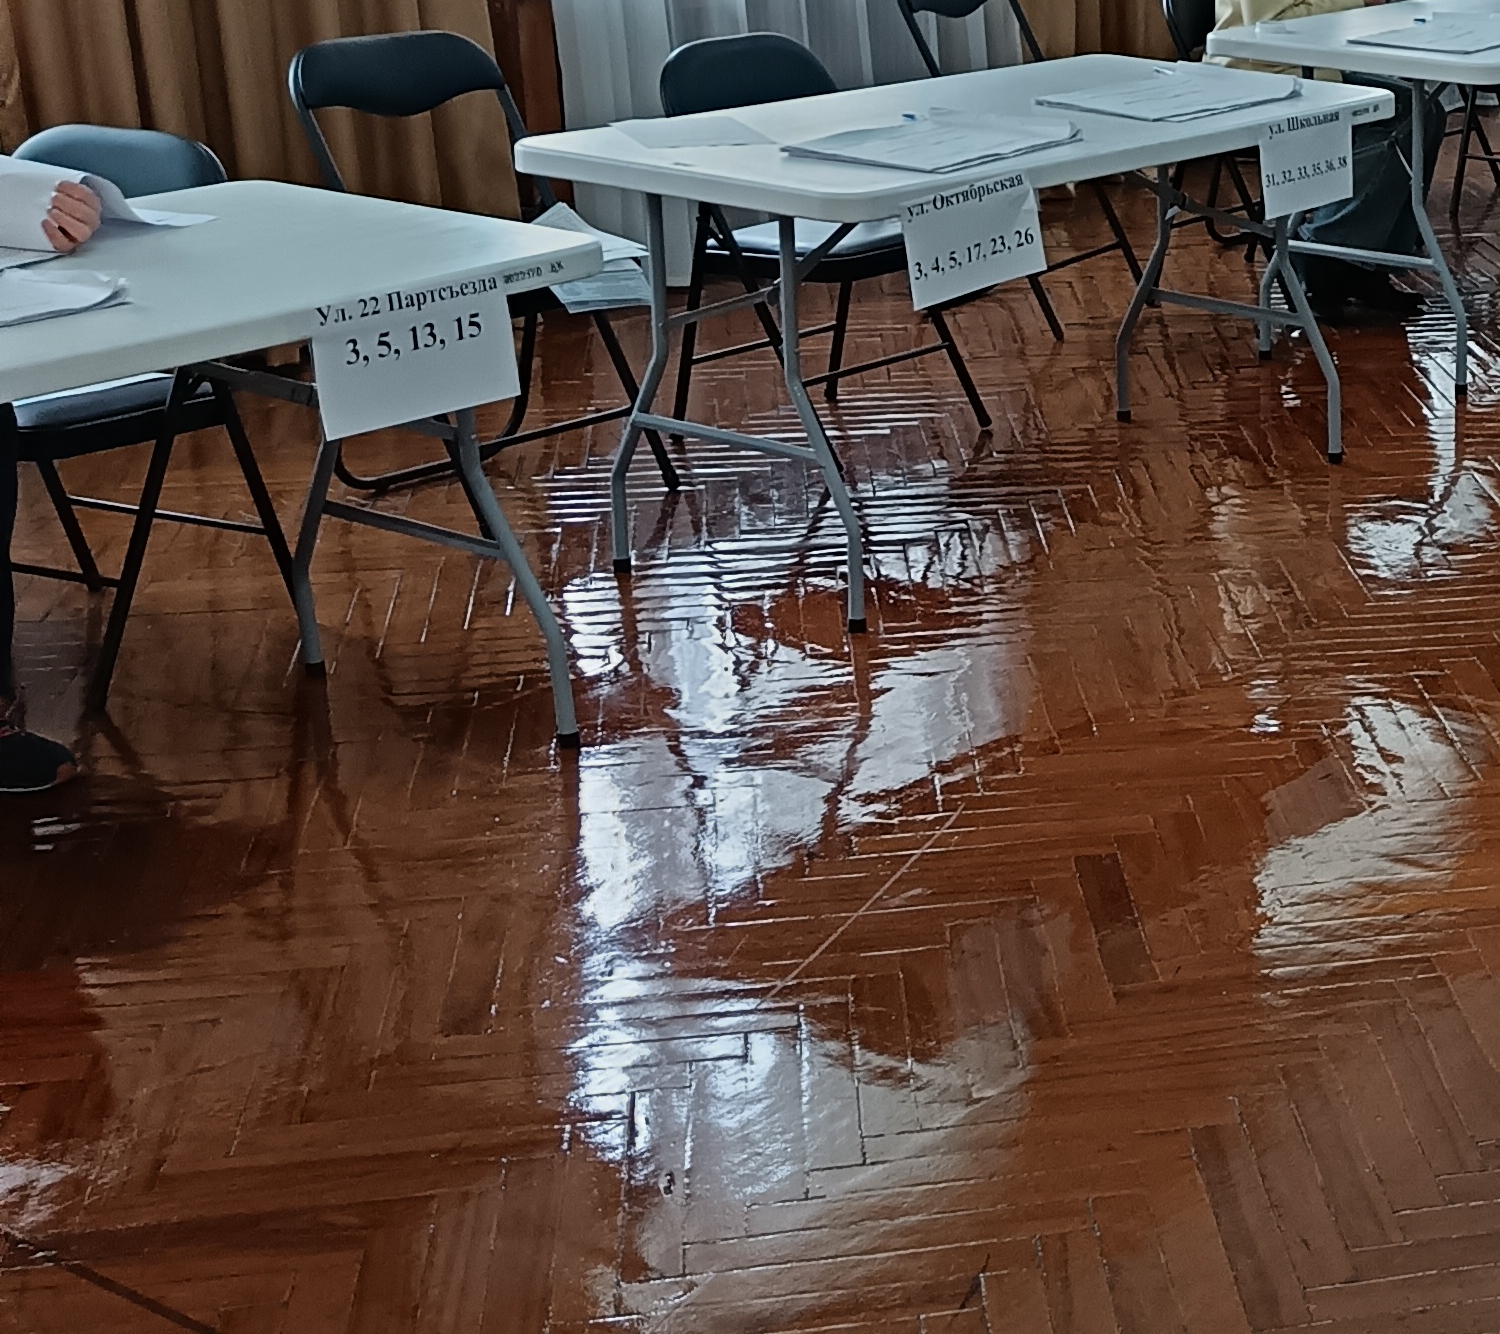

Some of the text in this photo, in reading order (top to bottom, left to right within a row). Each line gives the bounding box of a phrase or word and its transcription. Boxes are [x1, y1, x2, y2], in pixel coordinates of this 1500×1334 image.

[1268, 111, 1339, 140] ул. Школьная
[906, 173, 1024, 223] ул. Октябрьская
[914, 227, 1034, 281] 3, 4, 5, 17, 23, 26
[315, 275, 498, 326] Ул. 22 Партсъезда
[345, 312, 482, 367] 3, 5, 13, 15
